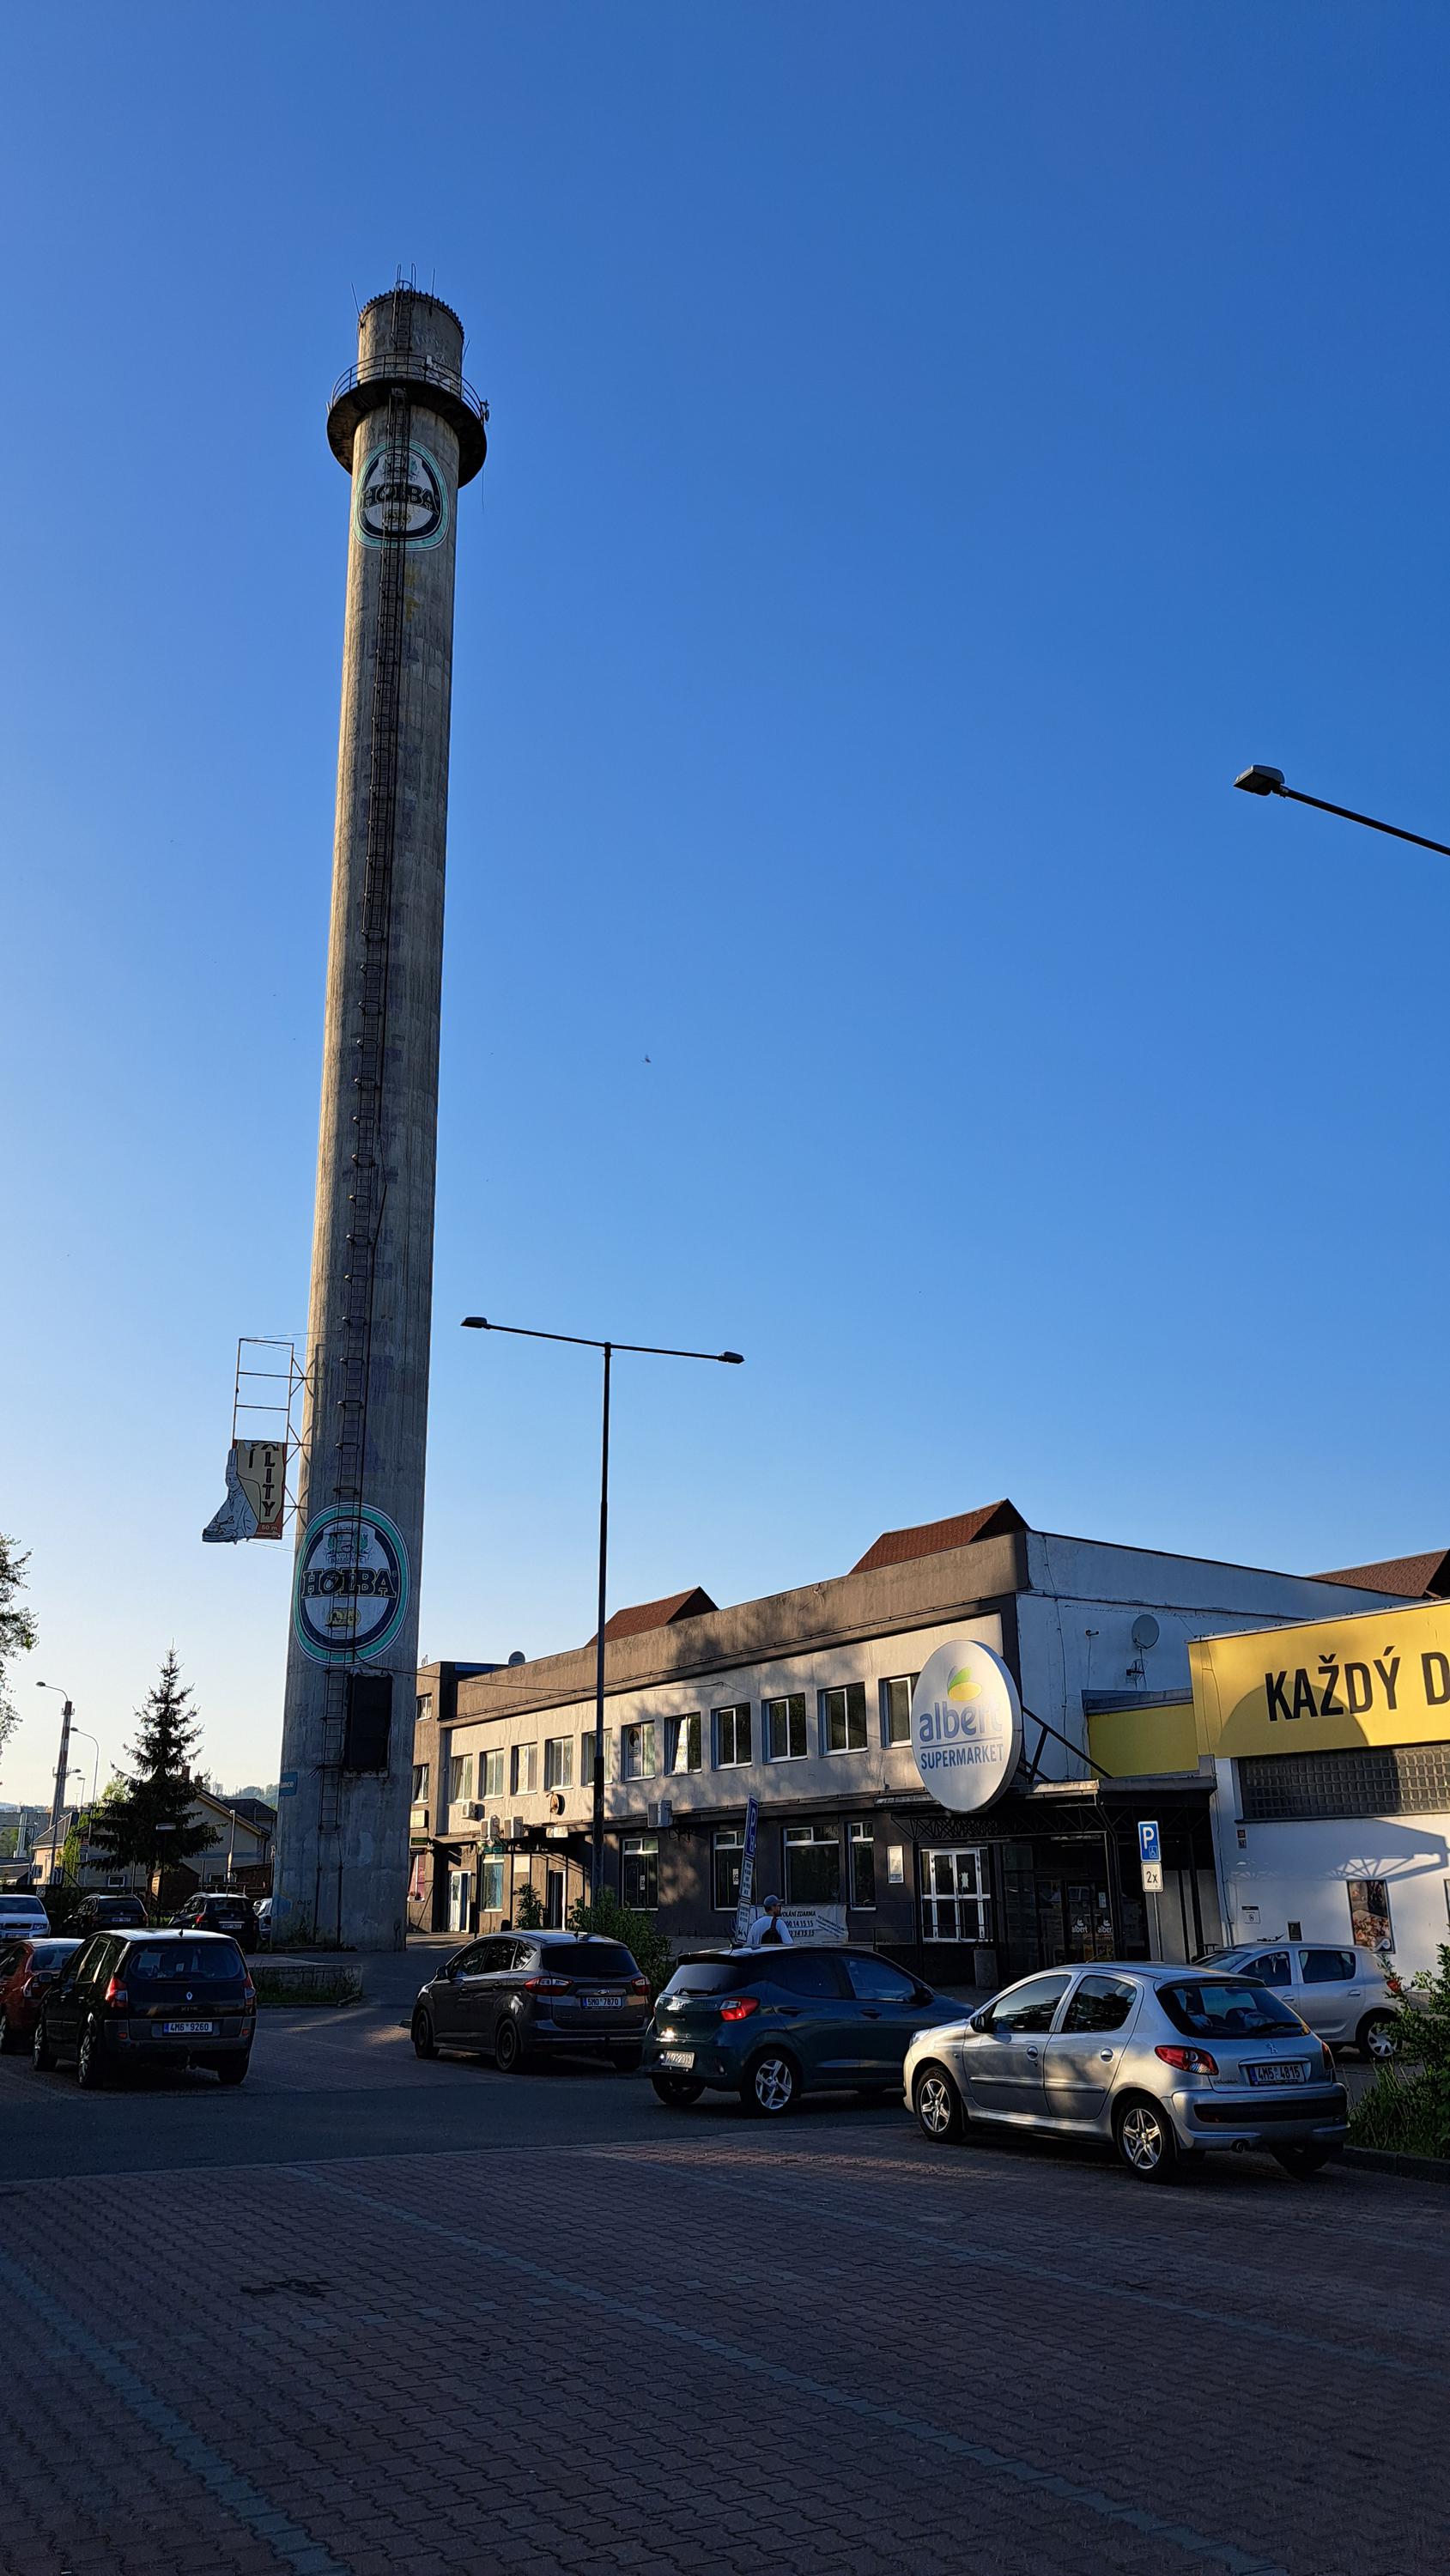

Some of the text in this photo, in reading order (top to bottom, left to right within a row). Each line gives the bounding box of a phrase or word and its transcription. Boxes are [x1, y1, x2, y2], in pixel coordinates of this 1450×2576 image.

[361, 483, 439, 515] HOLBA
[301, 1567, 397, 1599] HOLBA
[1265, 1645, 1401, 1722] KAŽDÝ
[919, 1700, 1003, 1742] albert
[920, 1743, 1004, 1771] SUPERMARKET
[1142, 1826, 1155, 1850] P
[1146, 1870, 1158, 1883] 2x
[1097, 1924, 1113, 1933] alber
[604, 1997, 619, 2006] 7870
[170, 2022, 209, 2032] 4M6 9260
[1258, 2066, 1301, 2081] 4M5 4815
